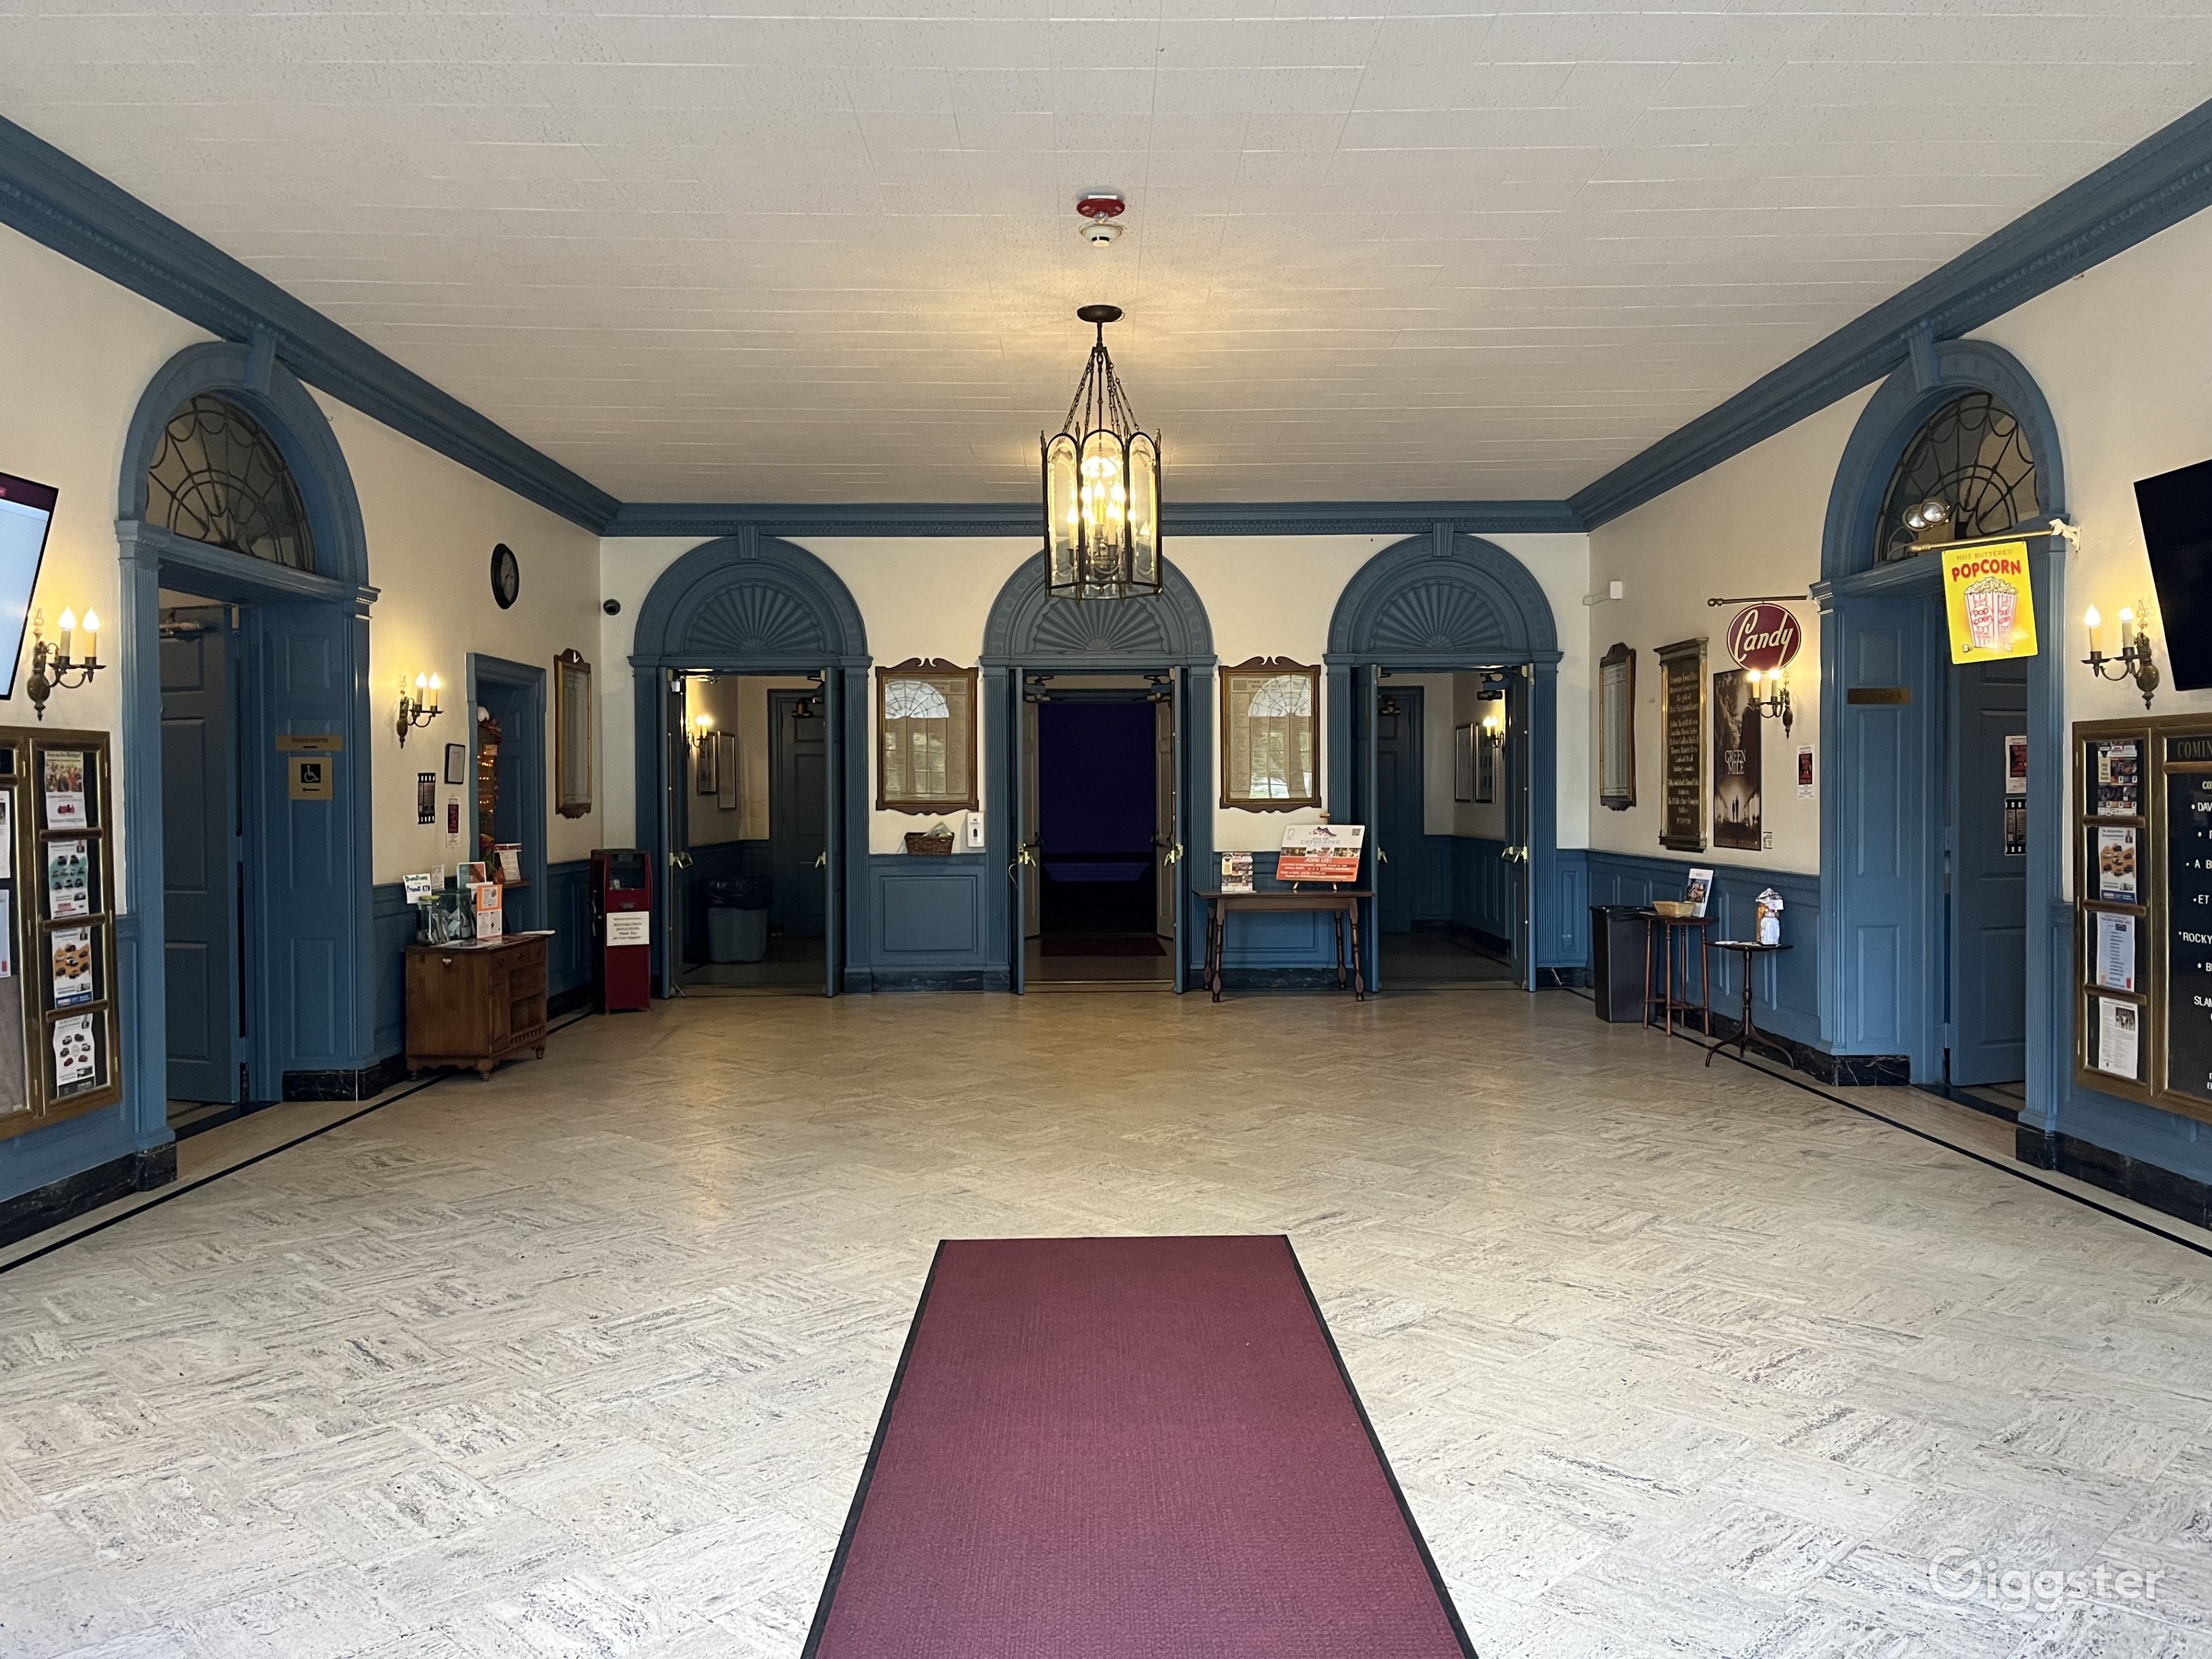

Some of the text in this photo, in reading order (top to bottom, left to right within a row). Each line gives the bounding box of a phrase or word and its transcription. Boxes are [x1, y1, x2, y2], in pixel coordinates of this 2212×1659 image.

[1975, 549, 2012, 559] BUTTERED
[1951, 559, 2021, 582] POPCORN
[1734, 609, 1794, 668] Candy
[1725, 749, 1747, 763] GREEN
[1728, 761, 1744, 775] MILE
[2202, 781, 2212, 790] CO
[2195, 859, 2200, 868] A
[2198, 895, 2210, 904] ET
[2183, 932, 2212, 944] ROCKY
